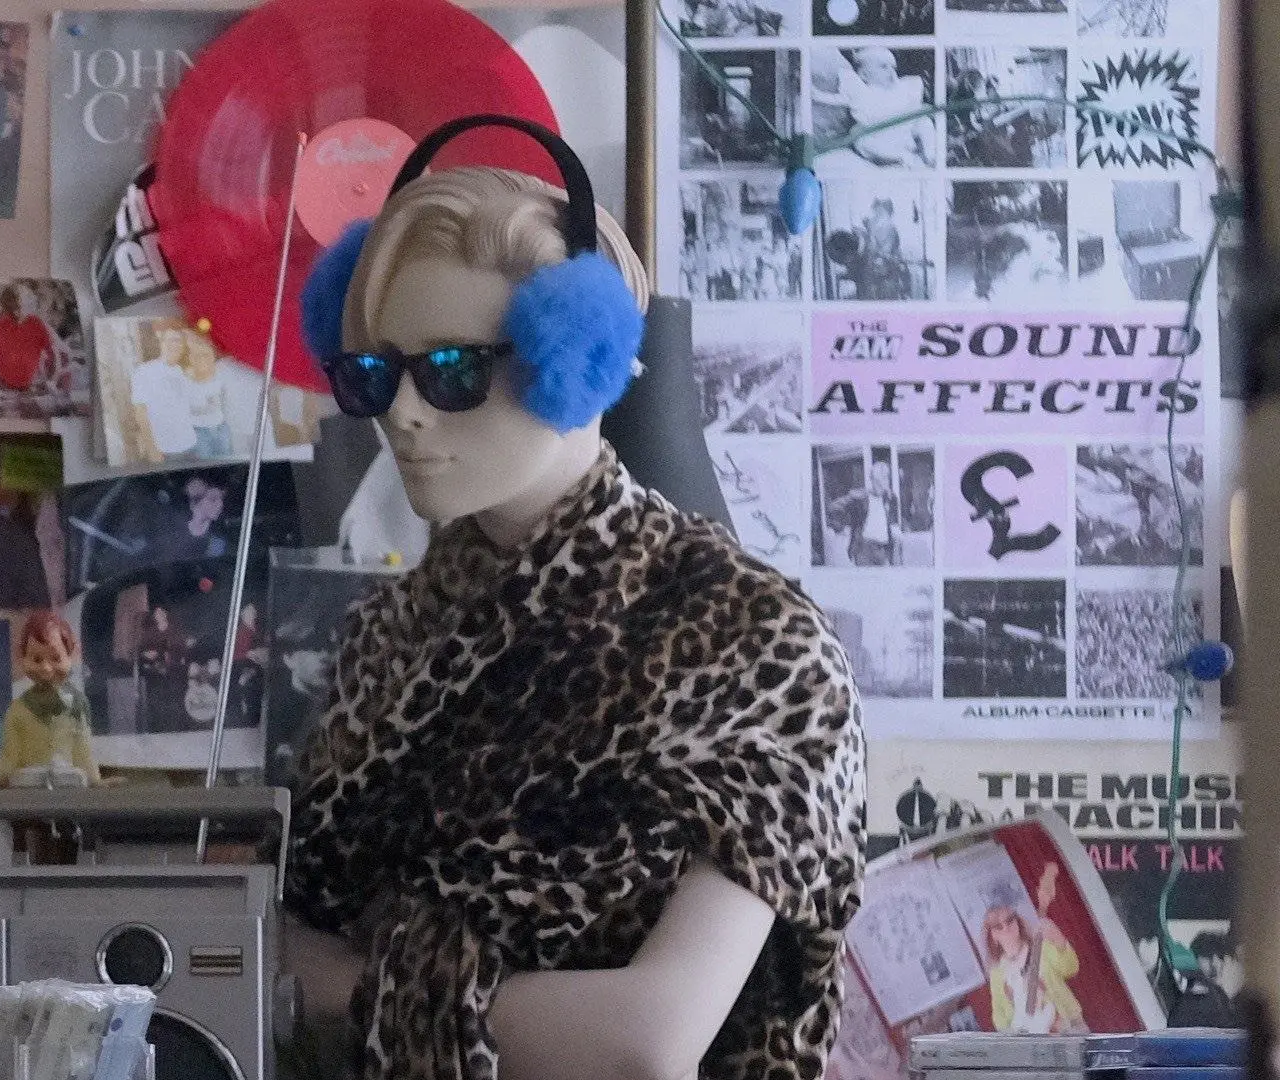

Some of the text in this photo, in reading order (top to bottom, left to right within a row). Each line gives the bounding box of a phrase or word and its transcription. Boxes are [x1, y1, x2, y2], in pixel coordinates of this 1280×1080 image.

[830, 335, 903, 361] JAM
[919, 323, 1203, 358] SOUND
[808, 379, 1202, 415] AFFECTS
[978, 771, 1088, 798] THE
